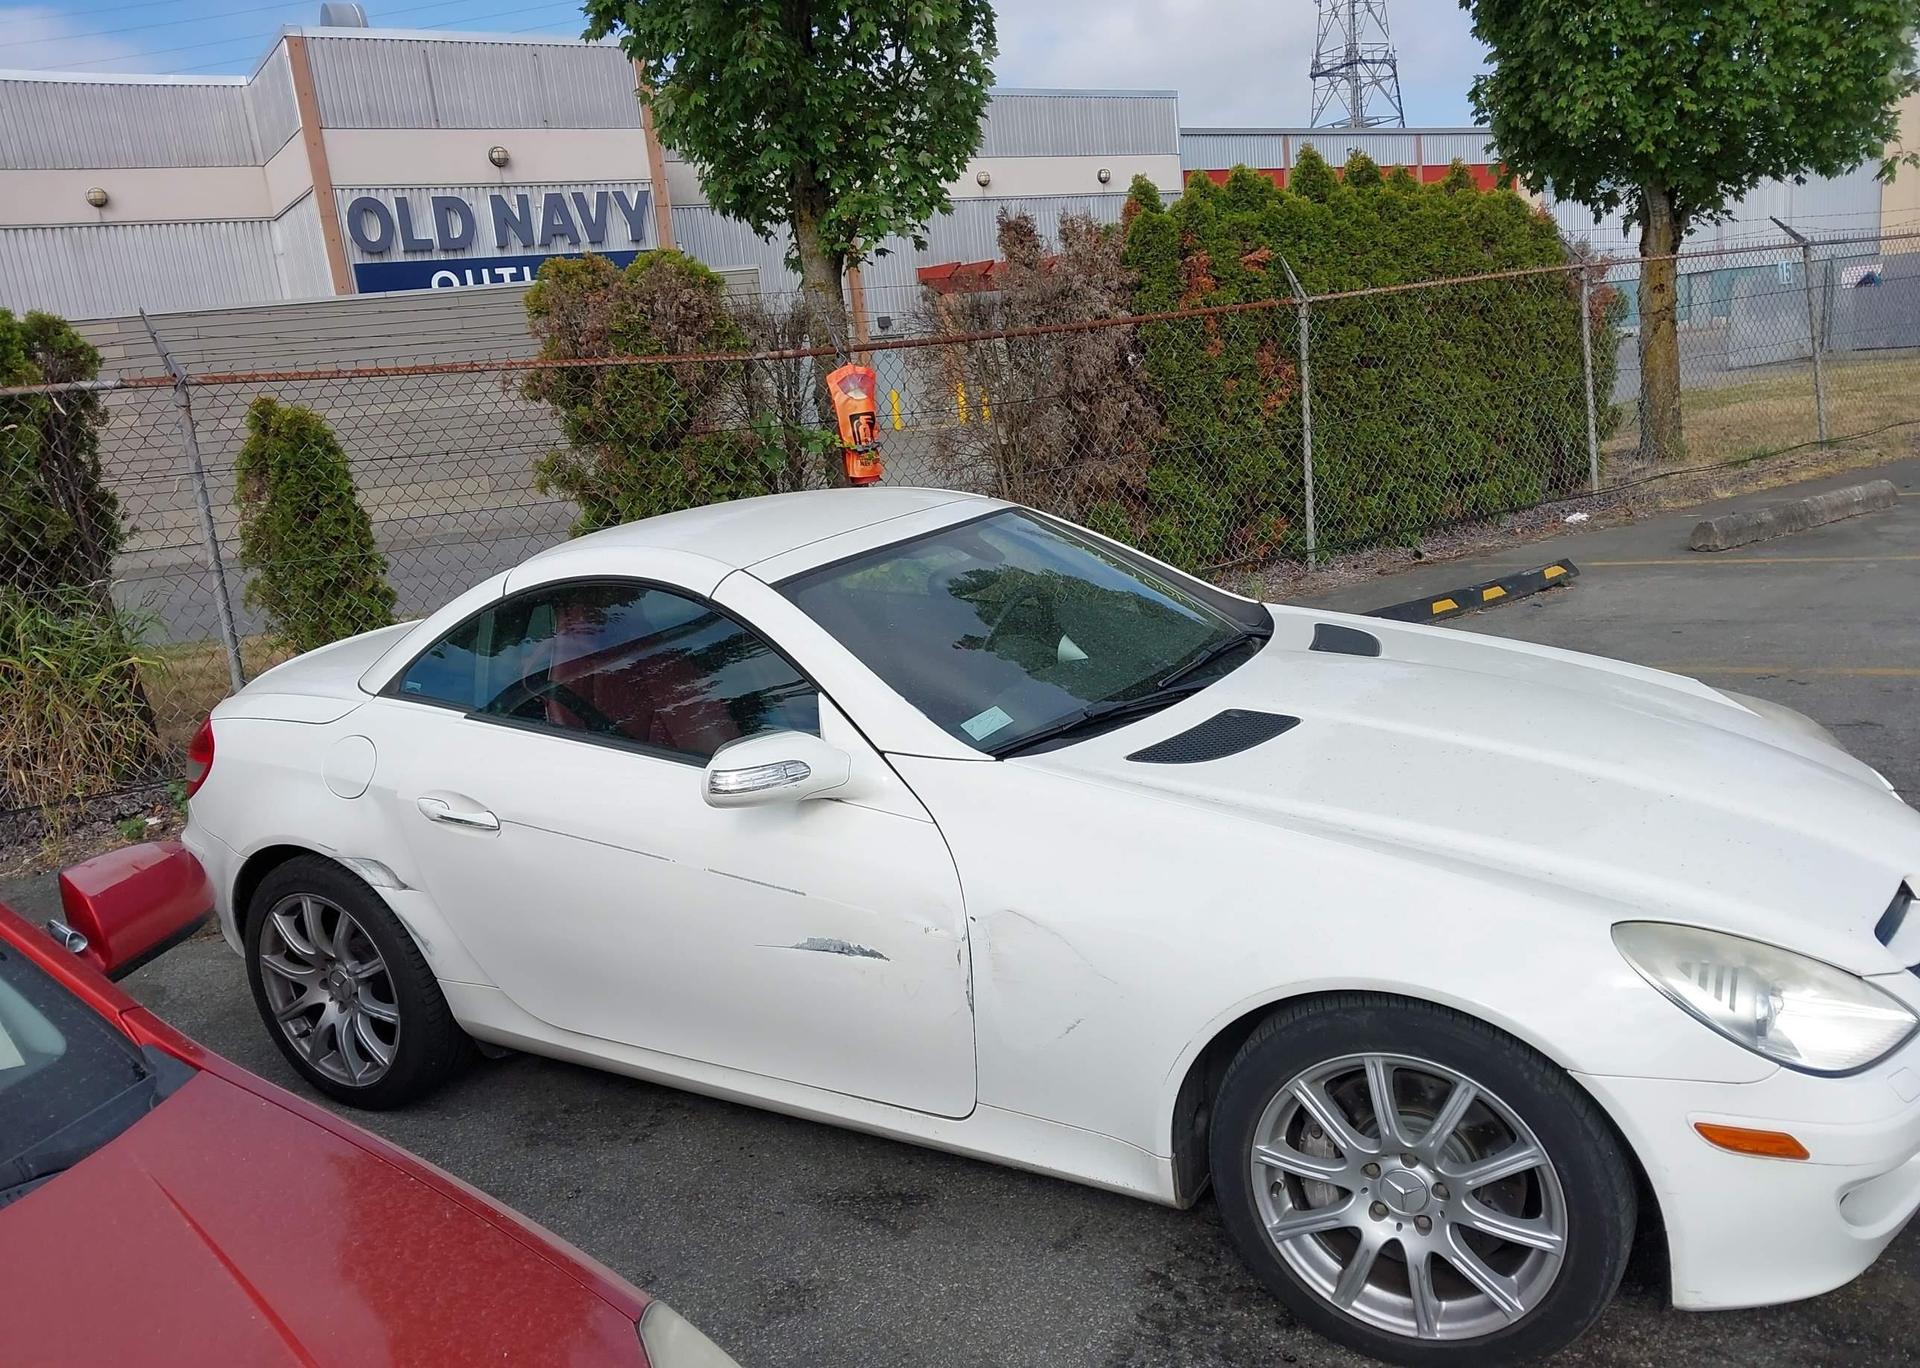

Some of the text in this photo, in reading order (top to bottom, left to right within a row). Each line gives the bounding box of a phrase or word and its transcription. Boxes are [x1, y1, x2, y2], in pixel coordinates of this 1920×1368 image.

[347, 190, 650, 253] OLD NAVY
[1780, 262, 1791, 282] 15
